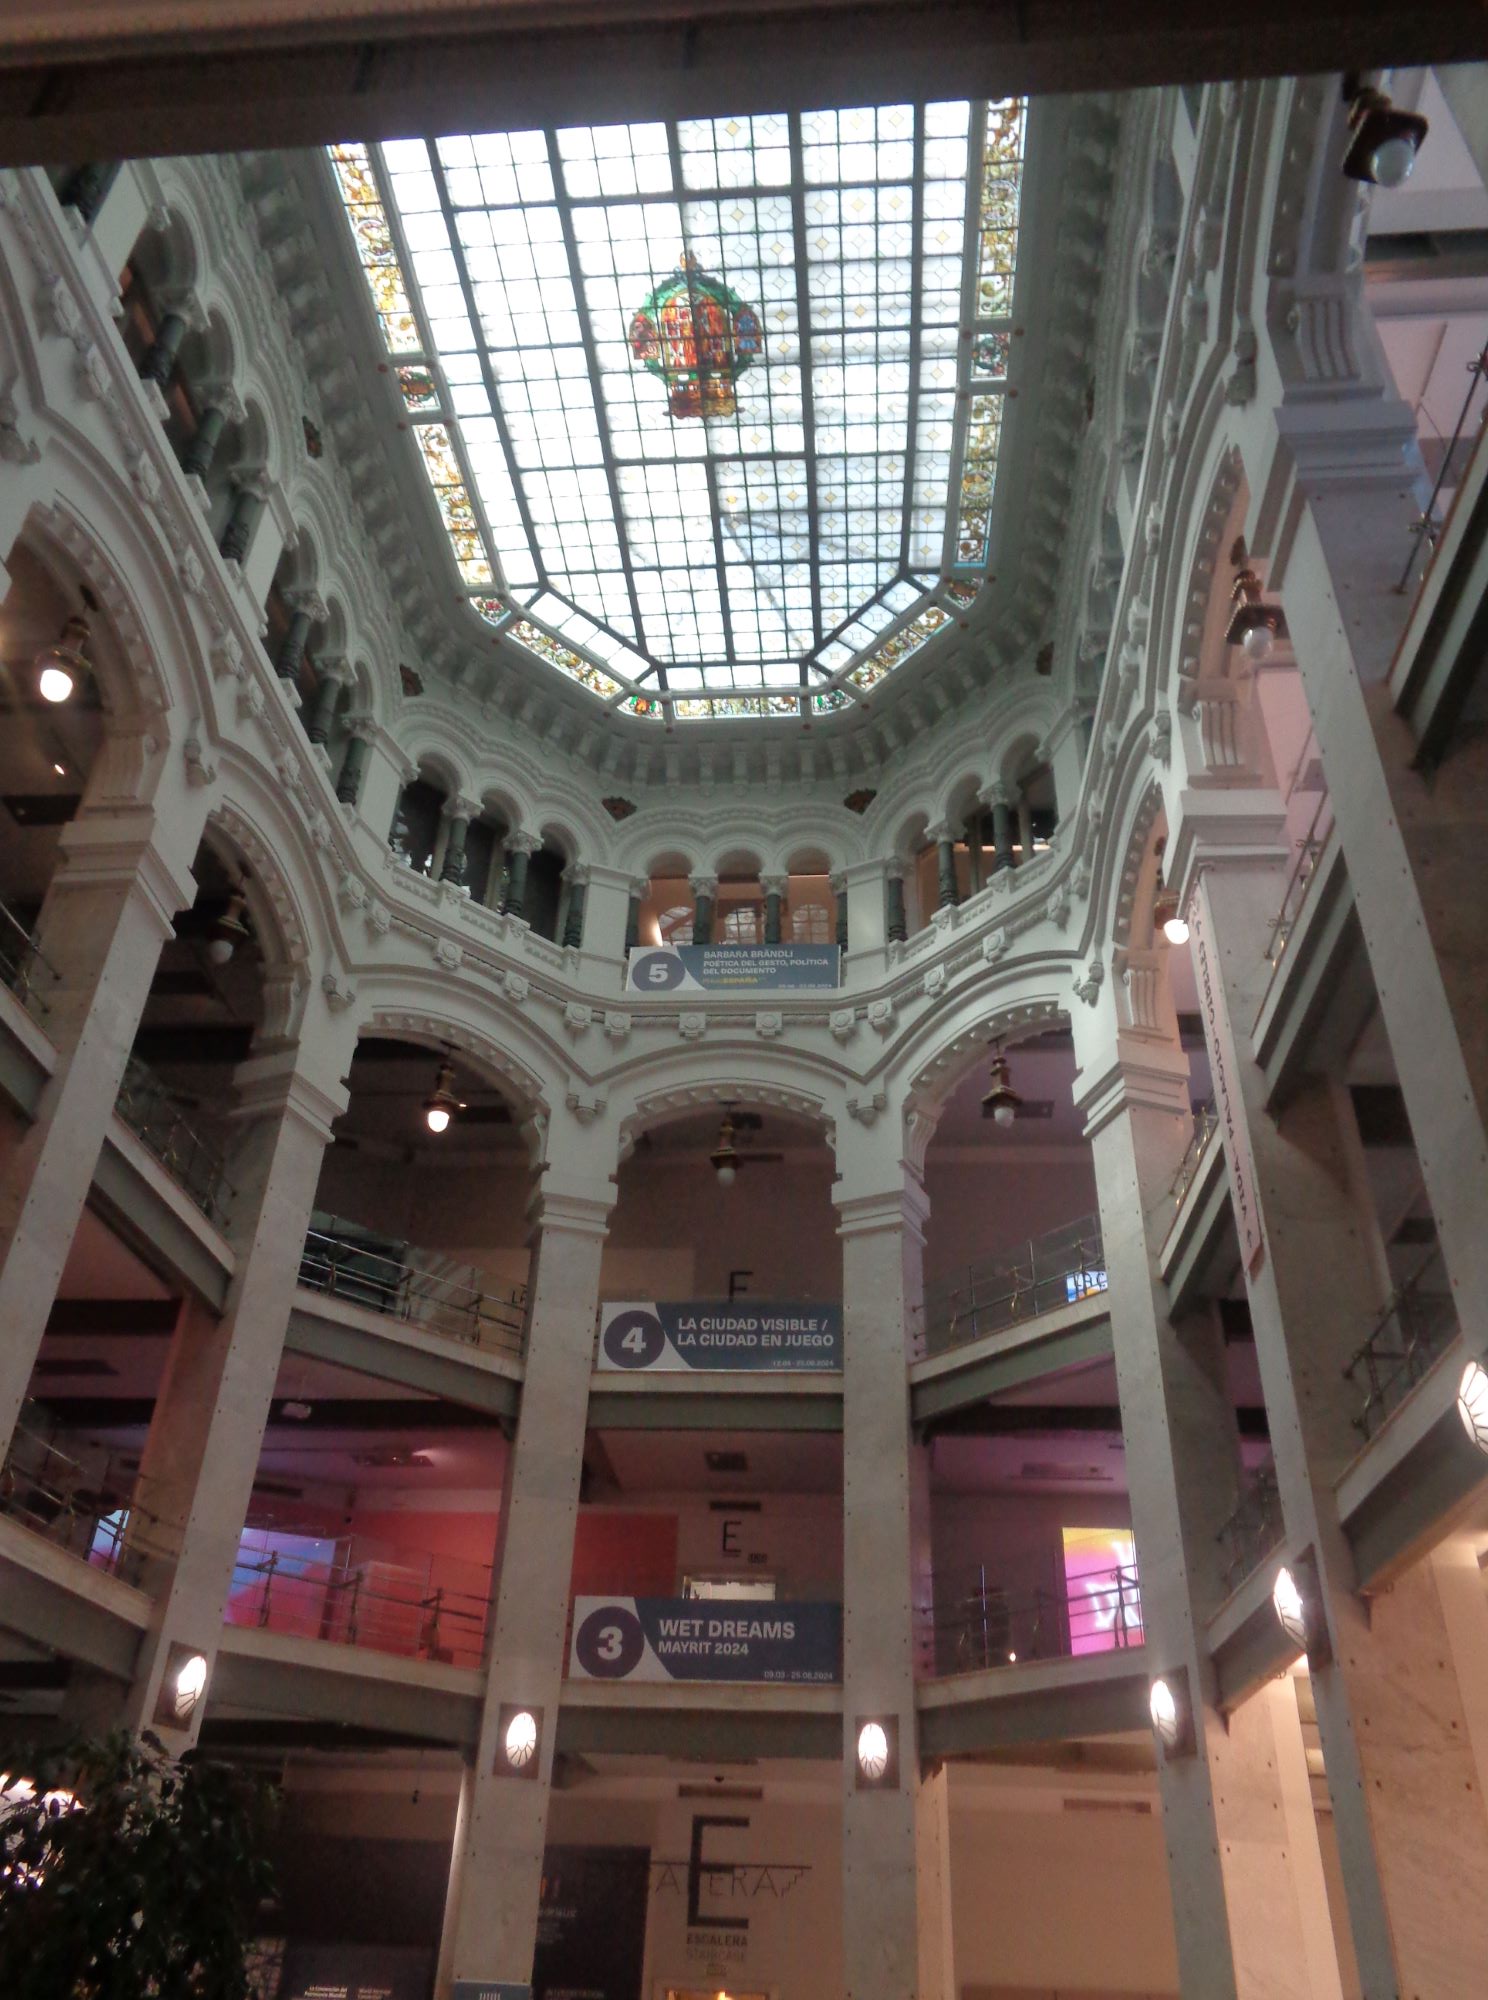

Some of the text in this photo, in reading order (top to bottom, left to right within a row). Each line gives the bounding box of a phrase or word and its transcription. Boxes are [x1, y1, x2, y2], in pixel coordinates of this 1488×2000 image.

[648, 963, 668, 983] 5
[703, 967, 777, 975] DEL DOCUMENTO
[1214, 1038, 1234, 1140] PALACIO
[679, 1318, 697, 1331] LA
[700, 1318, 758, 1332] CIUDAD
[761, 1318, 818, 1332] VISIBLE
[621, 1326, 647, 1354] 4
[677, 1333, 834, 1347] LA CIUDAD EN JUEGO
[659, 1619, 796, 1640] WET DREAMS
[597, 1625, 623, 1661] 3
[658, 1640, 749, 1656] MAYRIT 2024
[687, 1814, 750, 1929] E
[686, 1932, 749, 1948] ESCALERA
